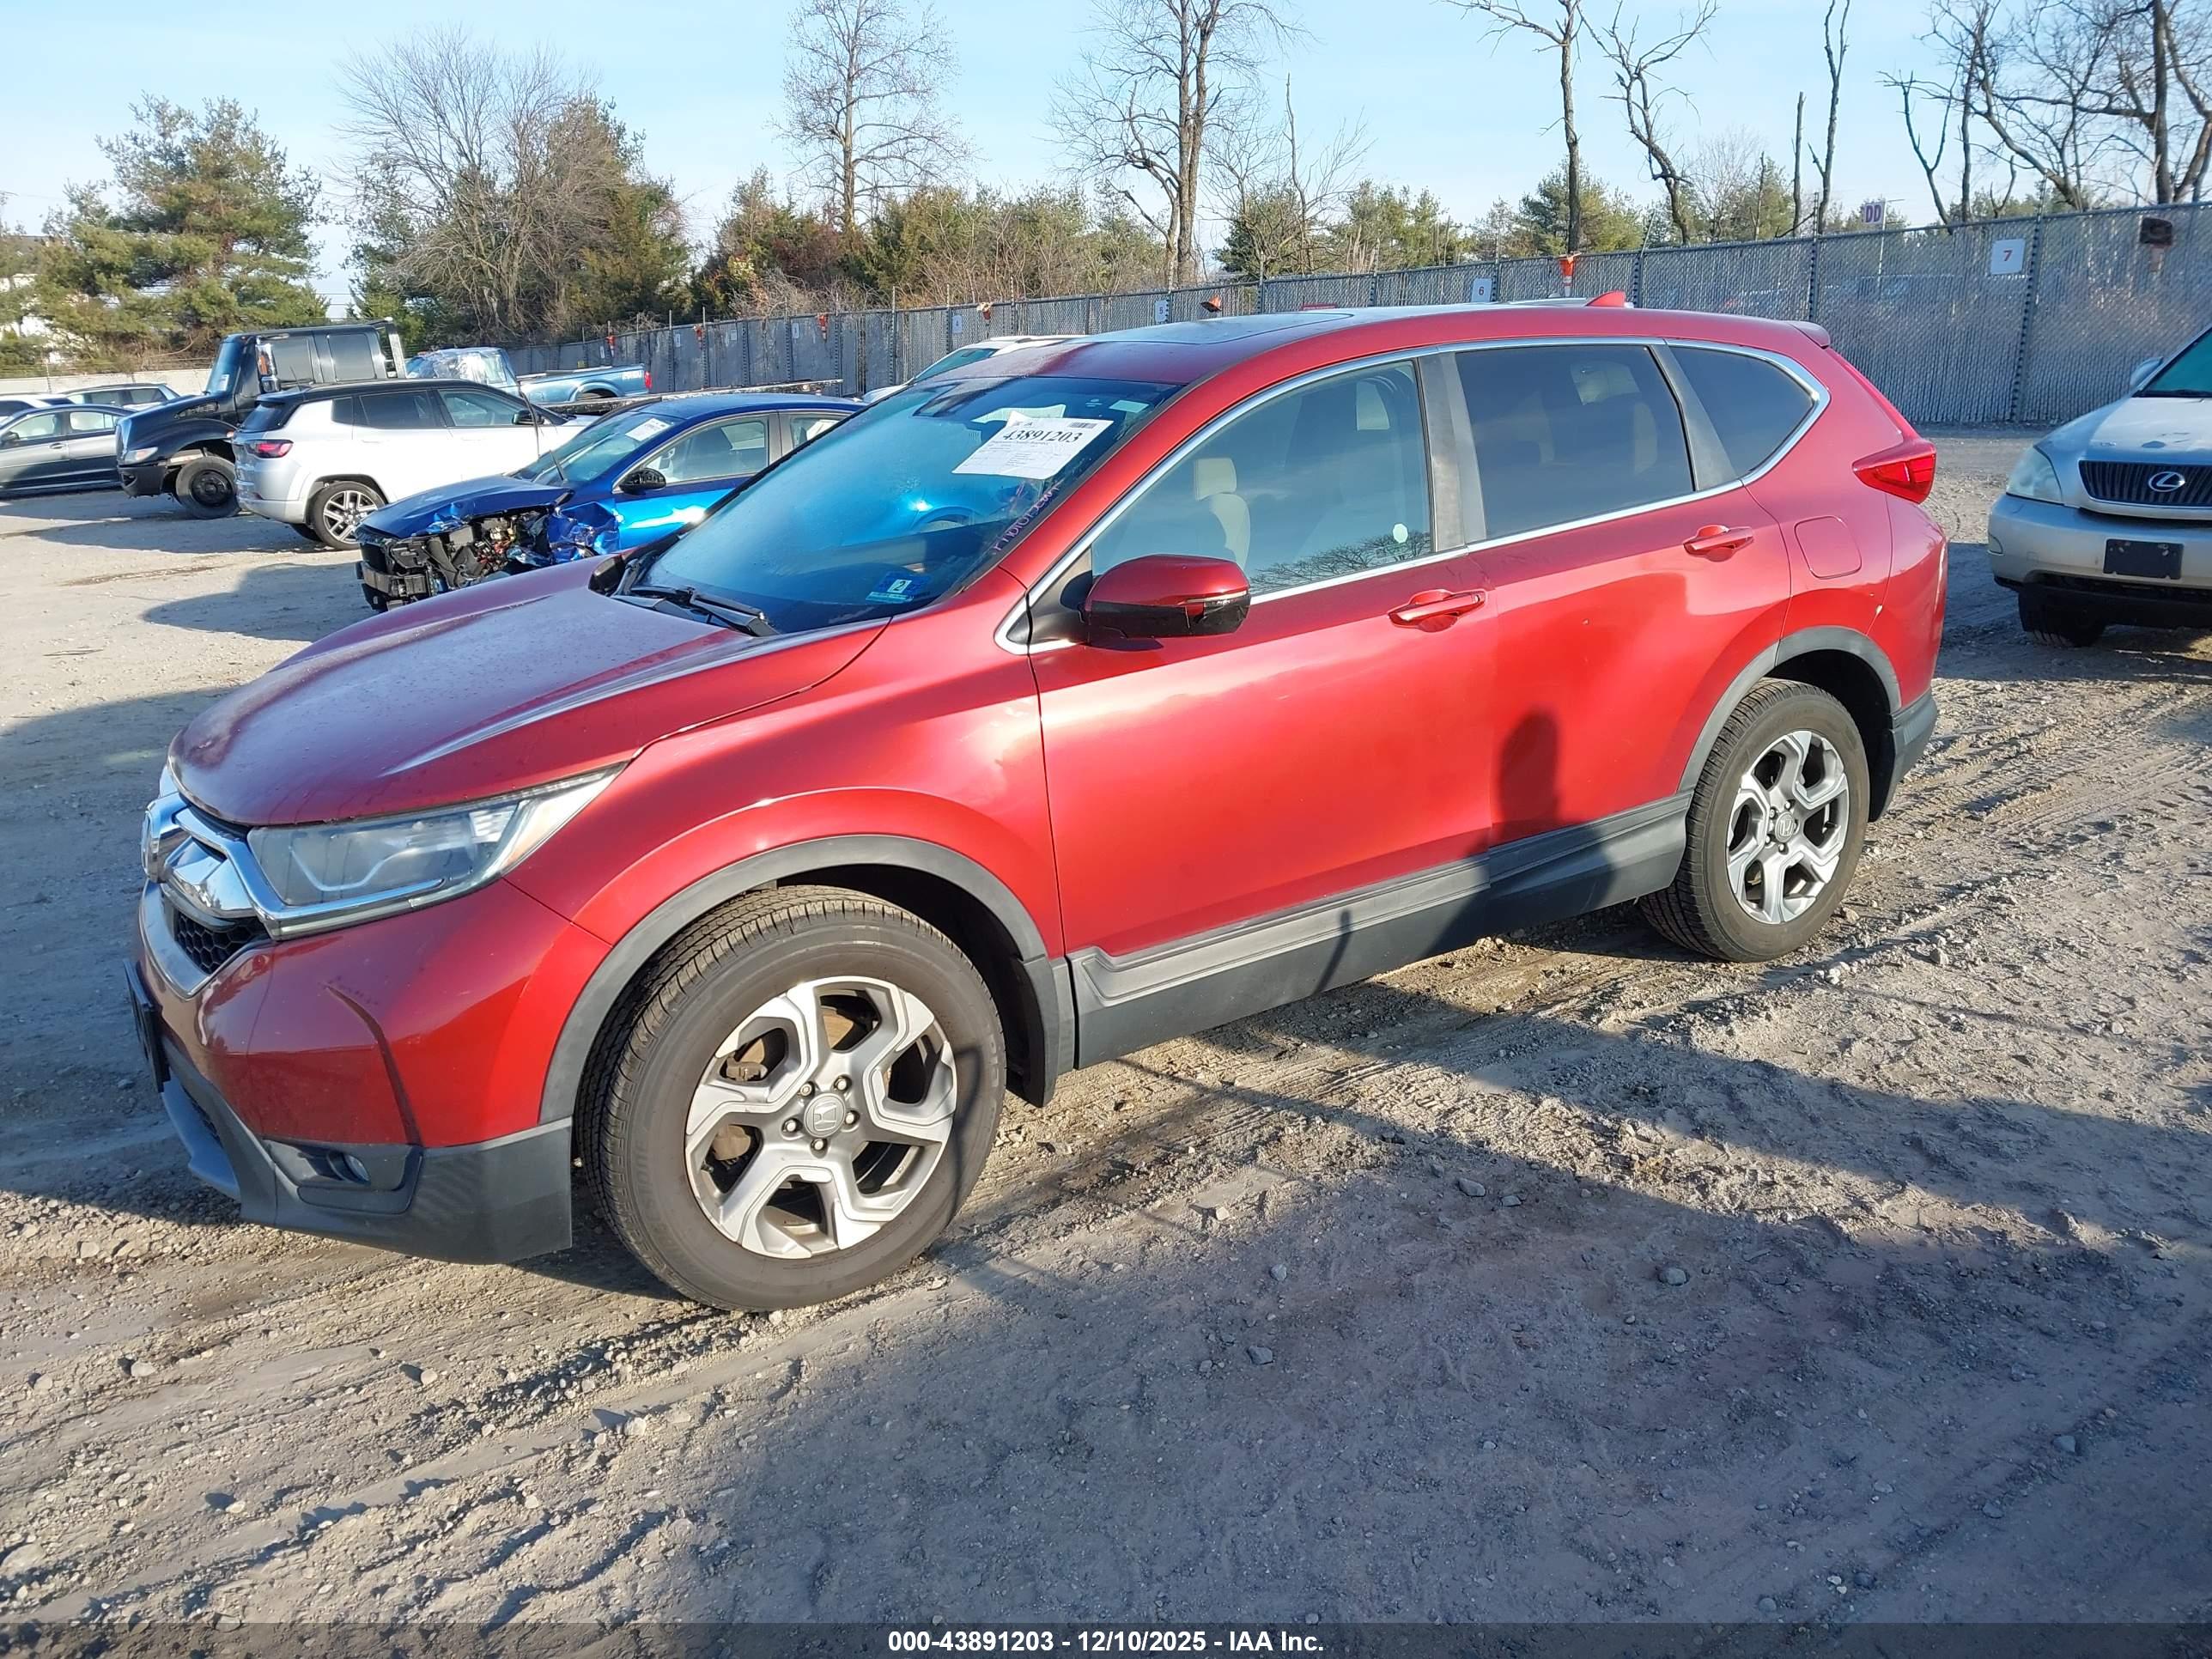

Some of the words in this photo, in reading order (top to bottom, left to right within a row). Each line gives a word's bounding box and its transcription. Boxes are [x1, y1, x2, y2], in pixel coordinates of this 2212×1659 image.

[1865, 204, 1882, 223] DD
[2002, 249, 2014, 262] 7
[1479, 286, 1485, 295] 6
[1003, 429, 1082, 443] 43891203
[893, 580, 906, 591] 2
